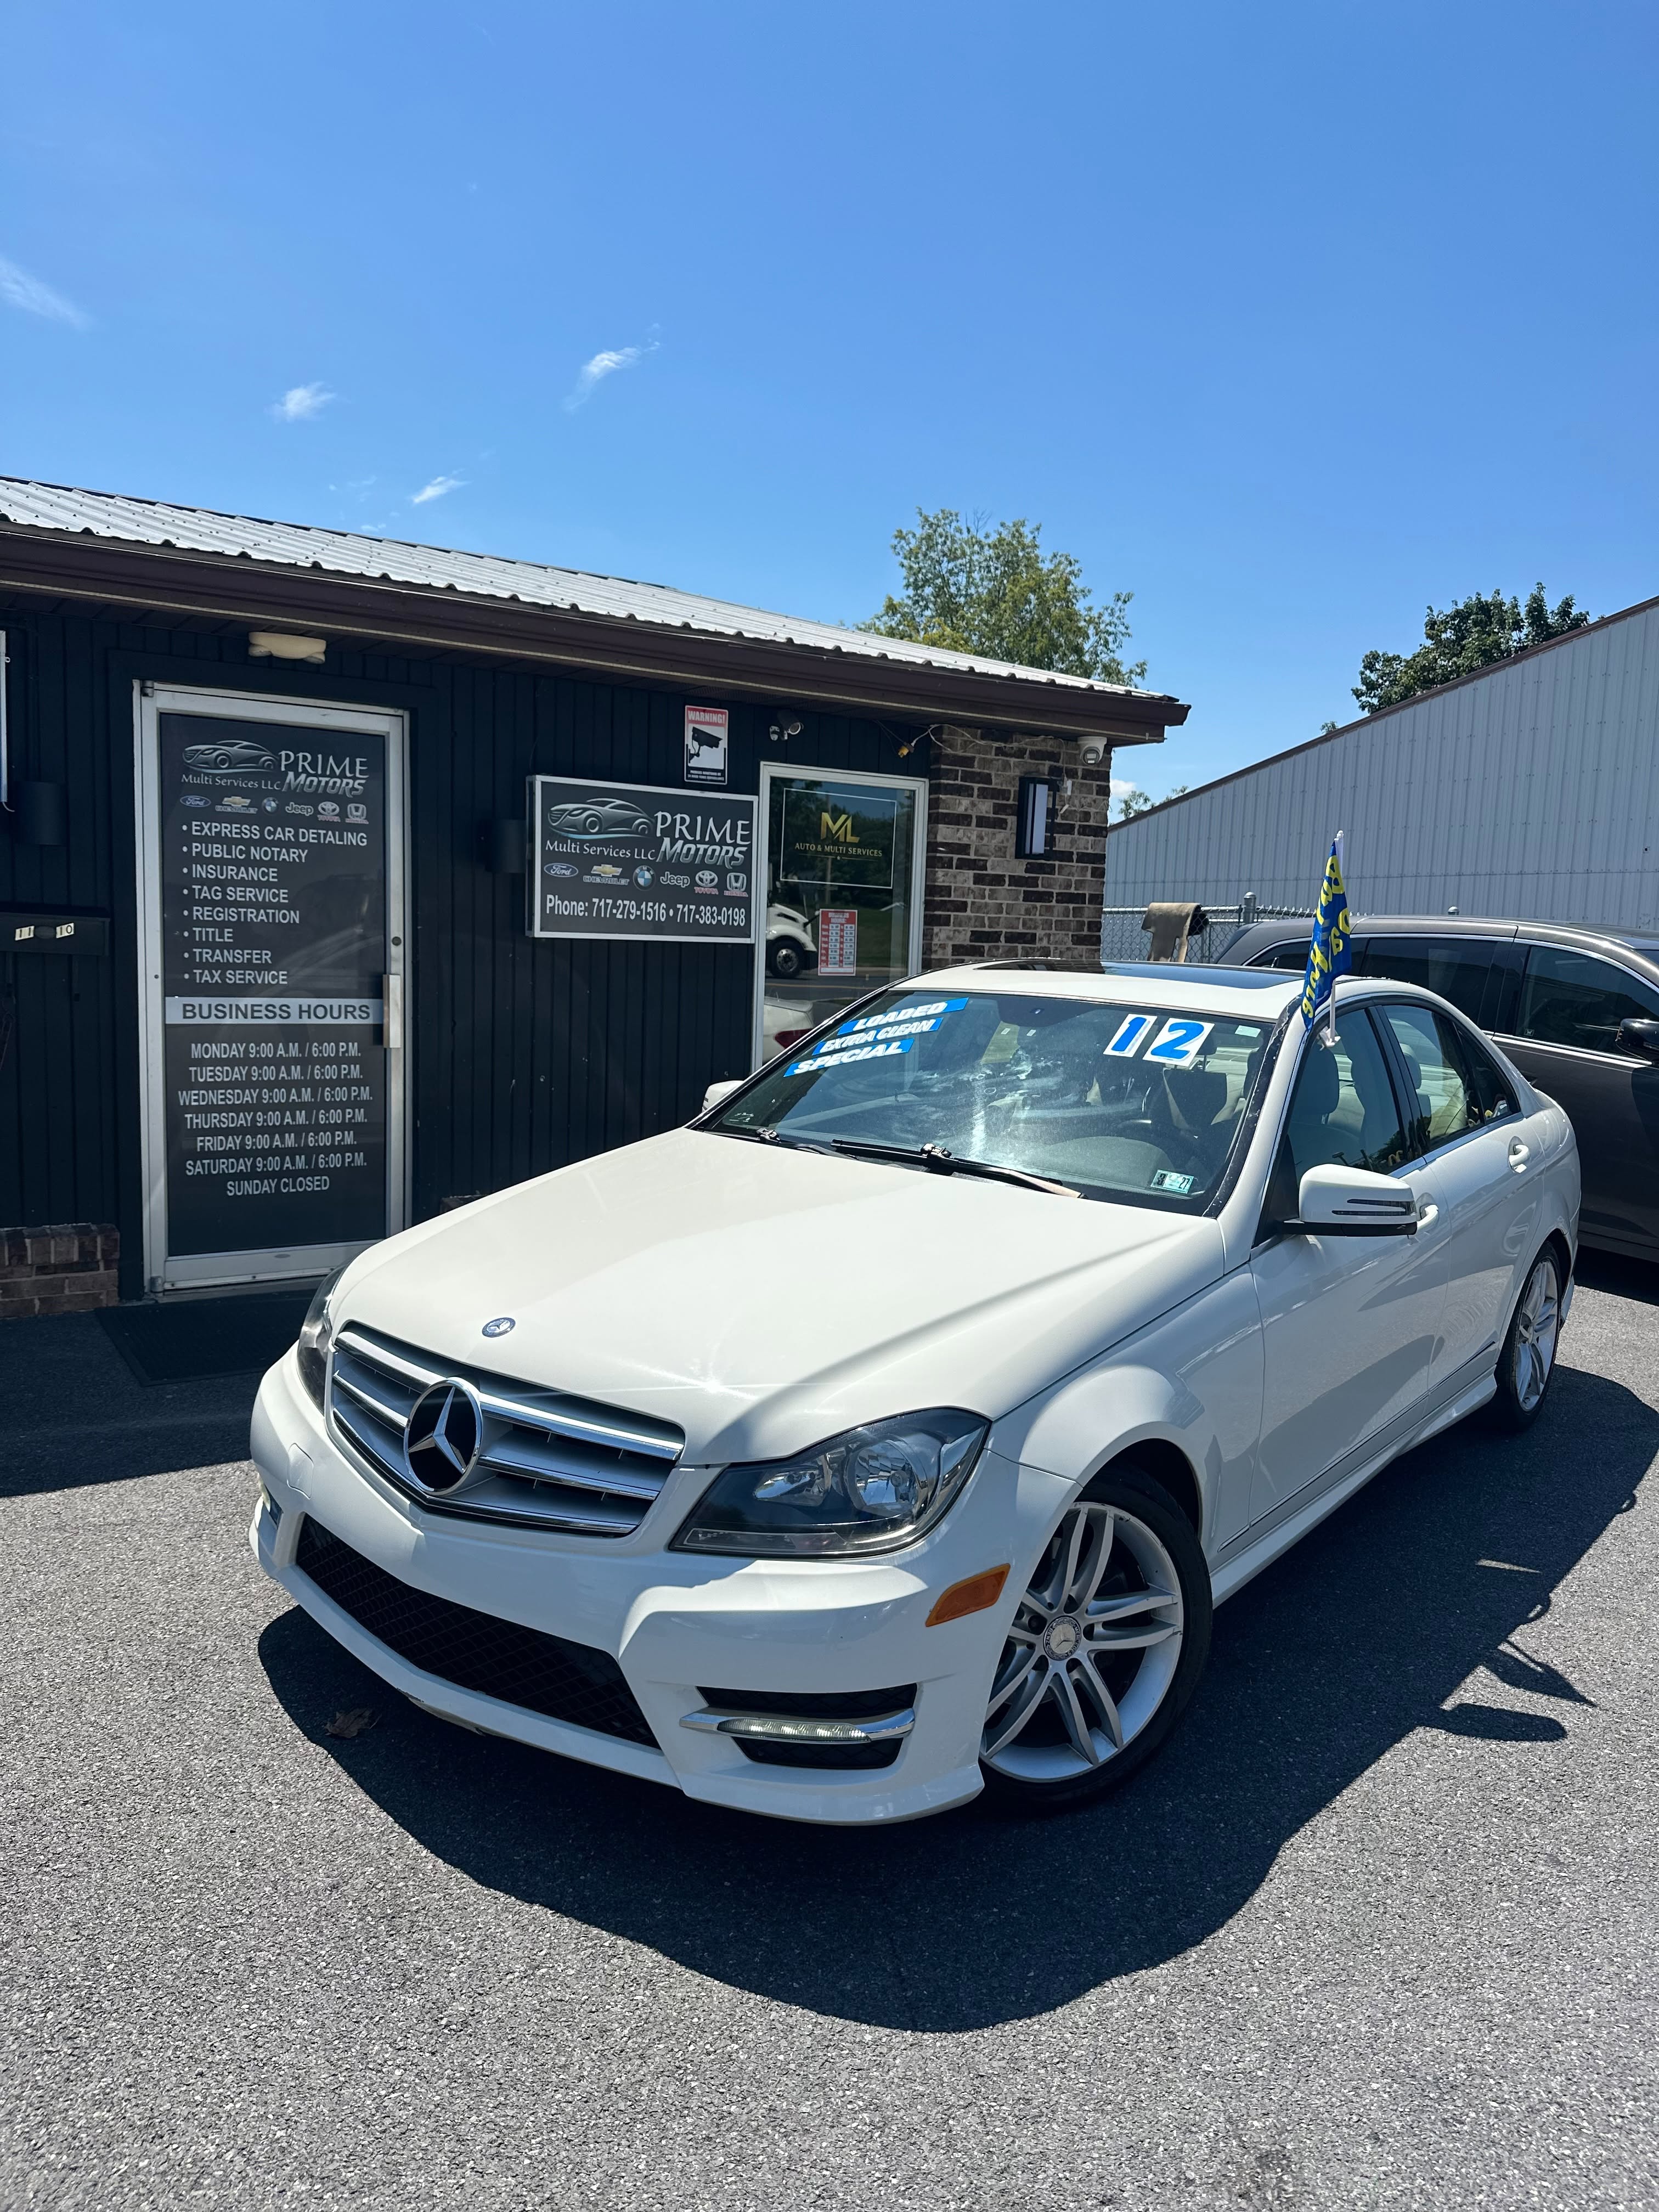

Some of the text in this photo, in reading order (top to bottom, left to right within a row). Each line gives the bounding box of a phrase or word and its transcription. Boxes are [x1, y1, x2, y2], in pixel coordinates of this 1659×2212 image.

[688, 710, 725, 724] WARNING!
[278, 751, 369, 778] PRIME
[181, 774, 281, 790] Multi Services LLC
[281, 771, 366, 798] MOTORS
[285, 802, 314, 816] Jeep
[192, 821, 367, 846] EXPRESS CAR DETALING
[654, 811, 751, 845] PRIME
[821, 812, 860, 843] ML
[193, 843, 308, 863] PUBLIC NOTARY
[546, 839, 656, 860] Multi Services LLC
[656, 837, 748, 869] MOTORS
[795, 843, 815, 851] AUTO
[825, 845, 845, 854] MULTI
[848, 847, 882, 857] SERVICES
[193, 865, 278, 882] INSURANCE
[550, 865, 571, 875] Ford
[583, 876, 629, 885] CHEVROLET
[660, 872, 690, 888] Jeep
[193, 885, 288, 903] TAG SERVICE
[193, 907, 300, 924] REGISTRATION
[546, 895, 746, 926] Phone: 717-279-1516 717-383-0198
[193, 928, 233, 943] TITLE
[193, 949, 272, 964] TRANSFER
[194, 970, 287, 984] TAX SERVICE
[183, 1003, 370, 1020] BUSINESS HOURS
[853, 1001, 948, 1031] LOADED
[820, 1019, 936, 1053] EXTRA CLEAN
[191, 1042, 360, 1059] MONDAY 9:00 A.M. / 6:00 P.M.
[793, 1042, 904, 1073] SPECIAL
[189, 1064, 363, 1082] TUESDAY 9:00 A.M. / 6:00 P.M.
[178, 1086, 373, 1105] WEDNESDAY 9:00 A.M. / 6:00 P.M.
[185, 1108, 367, 1128] THURSDAY 9:00 A.M. / 6:00 P.M.
[197, 1131, 357, 1152] FRIDAY 9:00 A.M. / 6:00 P.M.
[186, 1152, 367, 1175] SATURDAY 9:00 A.M. / 6:00 P.M.
[227, 1176, 330, 1196] SUNDAY CLOSED
[1178, 1177, 1190, 1190] 27
